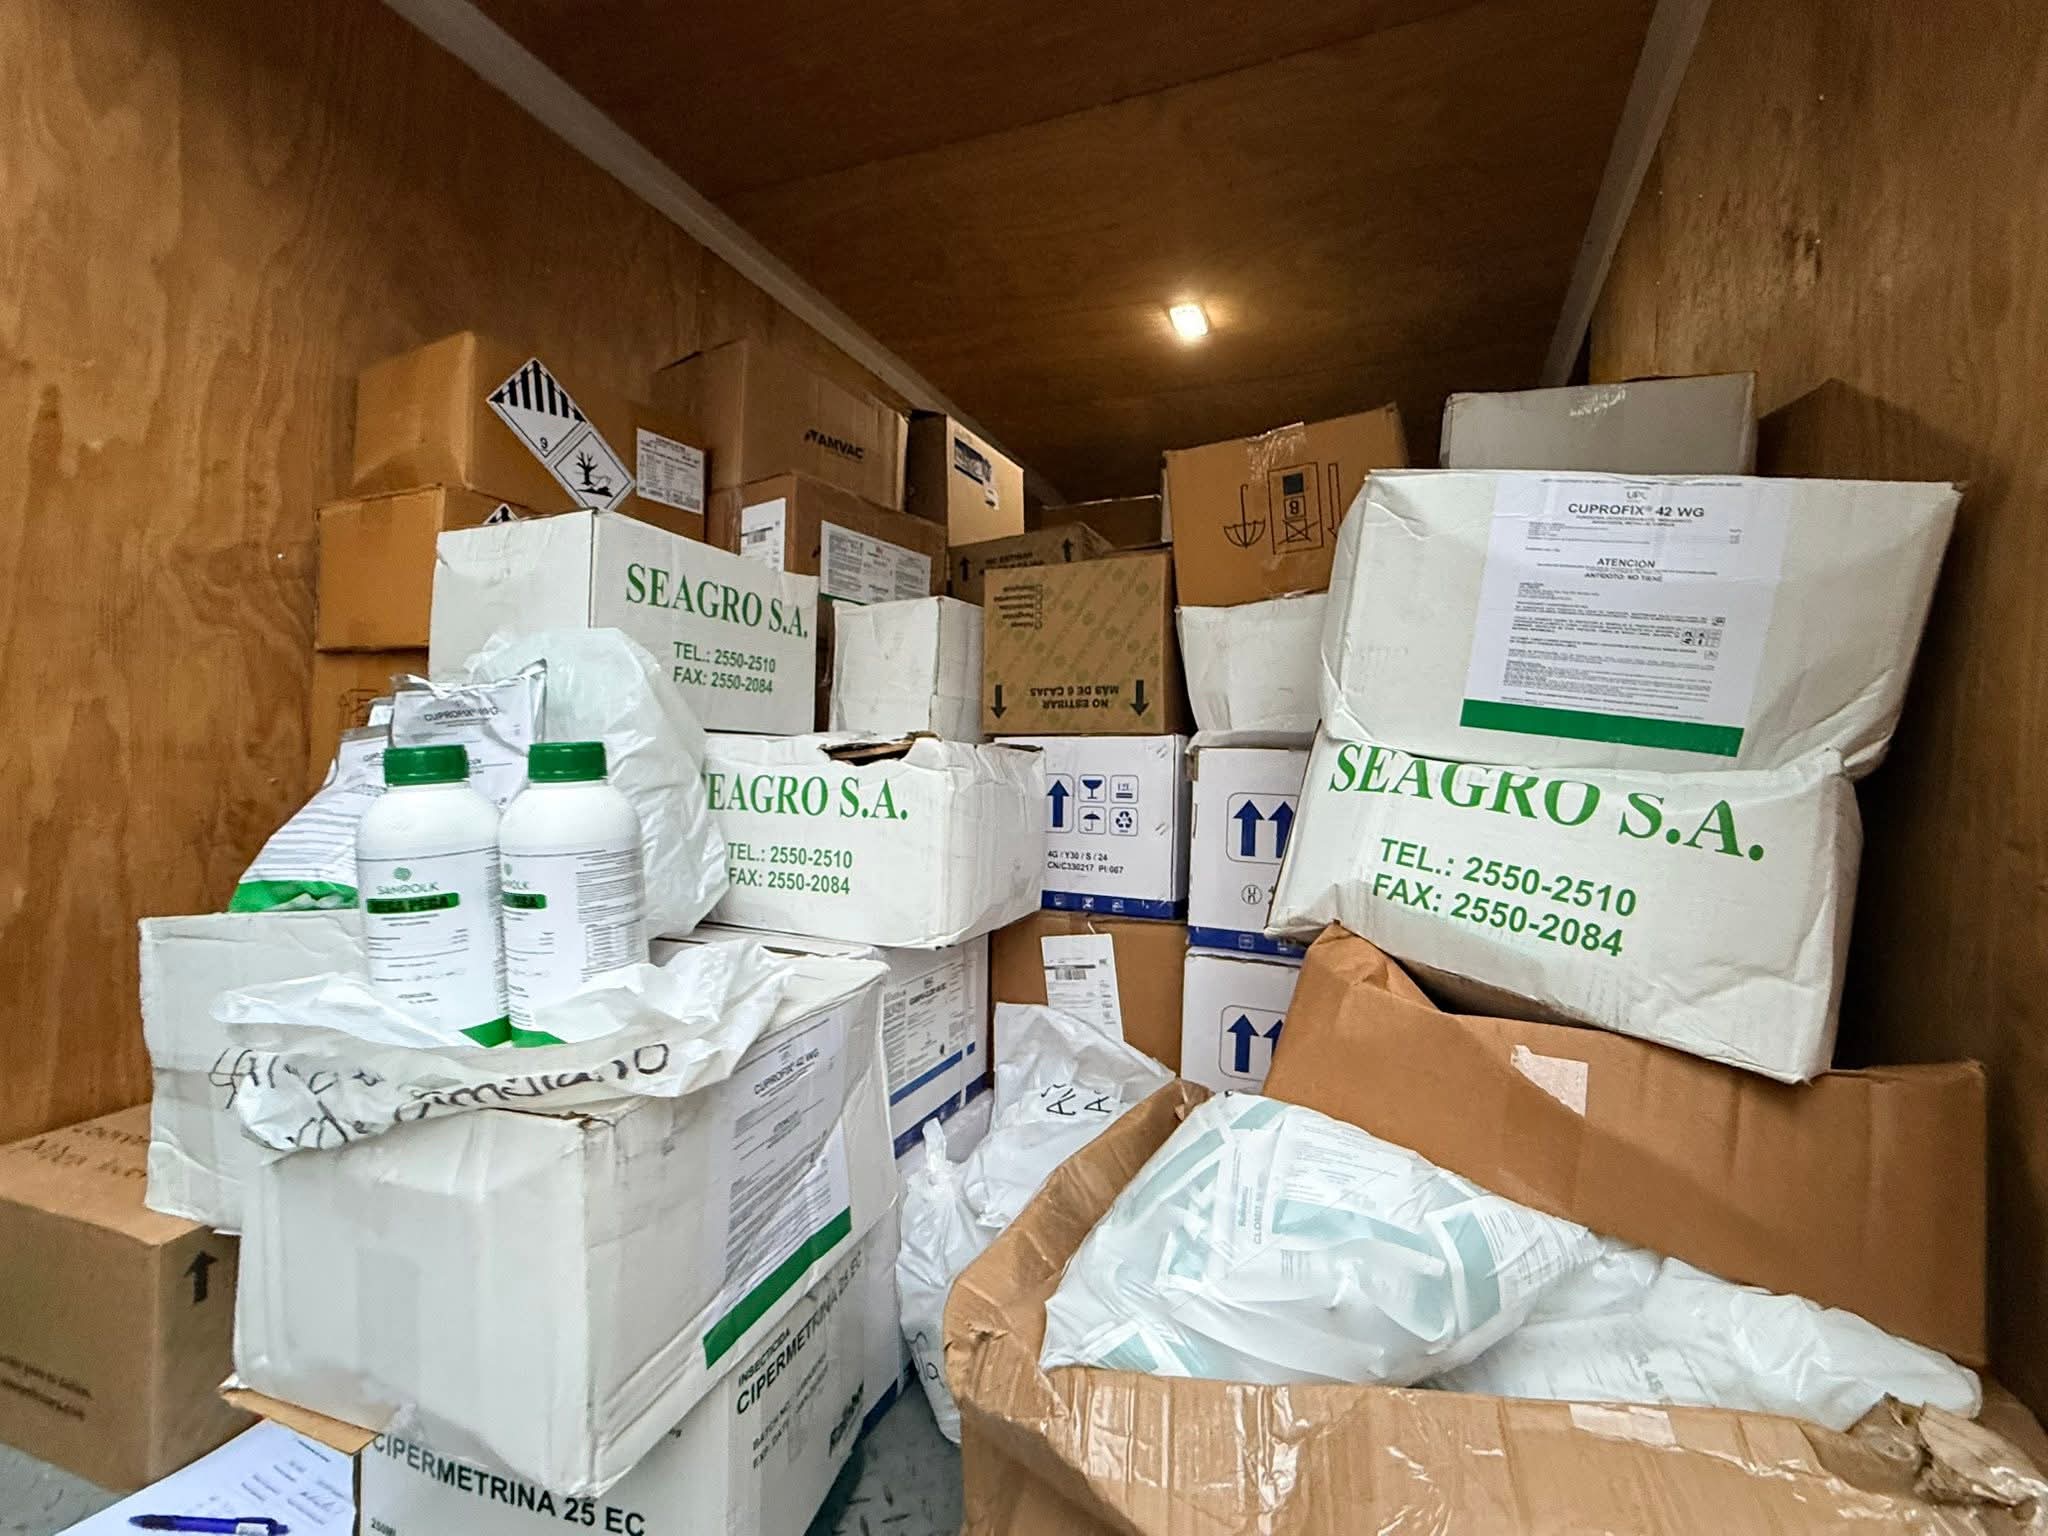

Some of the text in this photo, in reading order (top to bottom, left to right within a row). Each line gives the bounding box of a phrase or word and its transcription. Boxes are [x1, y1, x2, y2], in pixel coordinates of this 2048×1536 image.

[1656, 506, 1673, 517] 42
[1677, 507, 1704, 518] WG
[626, 563, 808, 638] SEAGRO S.A.
[673, 641, 776, 673] TEL.: 2550-2510
[673, 666, 773, 693] FAX: 2550-2084
[1076, 685, 1092, 696] DE
[1092, 698, 1109, 709] NO
[702, 772, 908, 821] EAGRO S.A.
[1329, 743, 1765, 861] SEAGRO S.A.
[728, 842, 853, 869] TEL.: 2550-2510
[728, 867, 851, 895] FAX: 2550-2084
[1380, 838, 1637, 917] TEL.: 2550-2510
[1372, 873, 1624, 958] FAX: 2550-2084
[371, 1433, 647, 1536] CIPERMETRINA 25 EC
